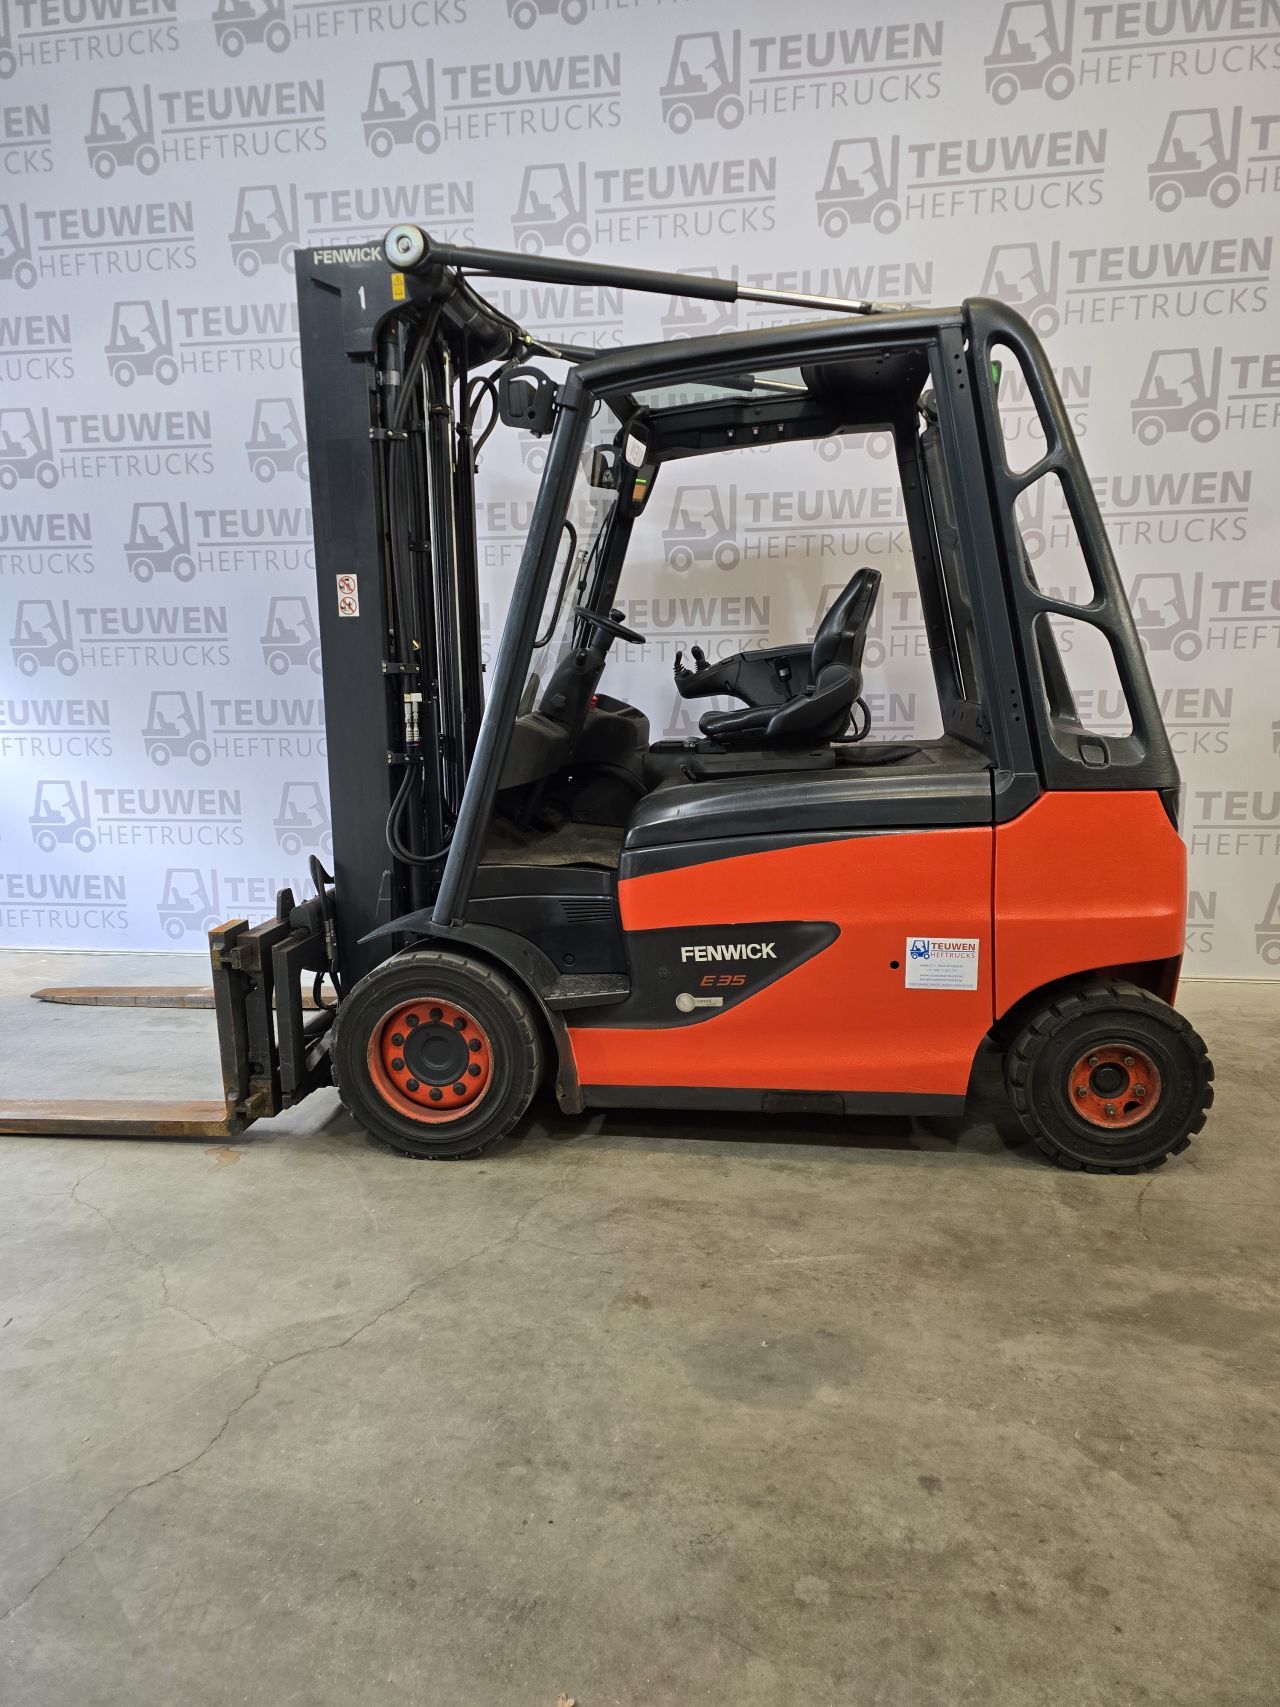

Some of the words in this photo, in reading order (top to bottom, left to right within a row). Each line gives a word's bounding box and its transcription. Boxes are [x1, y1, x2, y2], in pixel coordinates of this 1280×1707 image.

[293, 0, 467, 40] HEFTRUCKS
[18, 26, 180, 67] HEFTRUCKS
[749, 20, 944, 73] TEUWEN
[442, 52, 621, 100] TEUWEN
[158, 79, 325, 124] TEUWEN
[748, 71, 941, 115] HEFTRUCKS
[444, 101, 621, 140] HEFTRUCKS
[162, 126, 327, 163] HEFTRUCKS
[908, 128, 1107, 178] TEUWEN
[594, 157, 776, 203] TEUWEN
[304, 181, 474, 224] TEUWEN
[906, 179, 1104, 220] HEFTRUCKS
[35, 201, 194, 241] TEUWEN
[594, 205, 776, 244] HEFTRUCKS
[38, 245, 196, 278] HEFTRUCKS
[313, 247, 382, 265] FENWICK
[1068, 236, 1273, 283] TEUWEN
[358, 286, 366, 310] 1
[1064, 286, 1268, 325] HEFTRUCKS
[0, 314, 71, 346] WEN
[177, 303, 299, 338] TEUW
[181, 346, 302, 374] HEFTRUC
[56, 410, 211, 444] TEUWEN
[60, 452, 214, 479] HEFTRUCKS
[0, 513, 92, 542] WEN
[194, 508, 313, 539] TEUW
[198, 549, 316, 573] HEFTRUC
[744, 531, 912, 560] HEFTRUCK
[76, 606, 228, 634] TEUWEN
[80, 645, 230, 667] HEFTRUCKS
[0, 699, 110, 726] UWEN
[211, 699, 325, 726] TEUW
[2, 737, 113, 757] FTRUCKS
[213, 737, 327, 758] HEFTRUC
[94, 788, 241, 815] TEUWEN
[98, 825, 243, 845] HEFTRUCKS
[0, 873, 126, 900] EUWEN
[681, 942, 777, 962] FENWICK
[930, 942, 976, 950] TEUWEN
